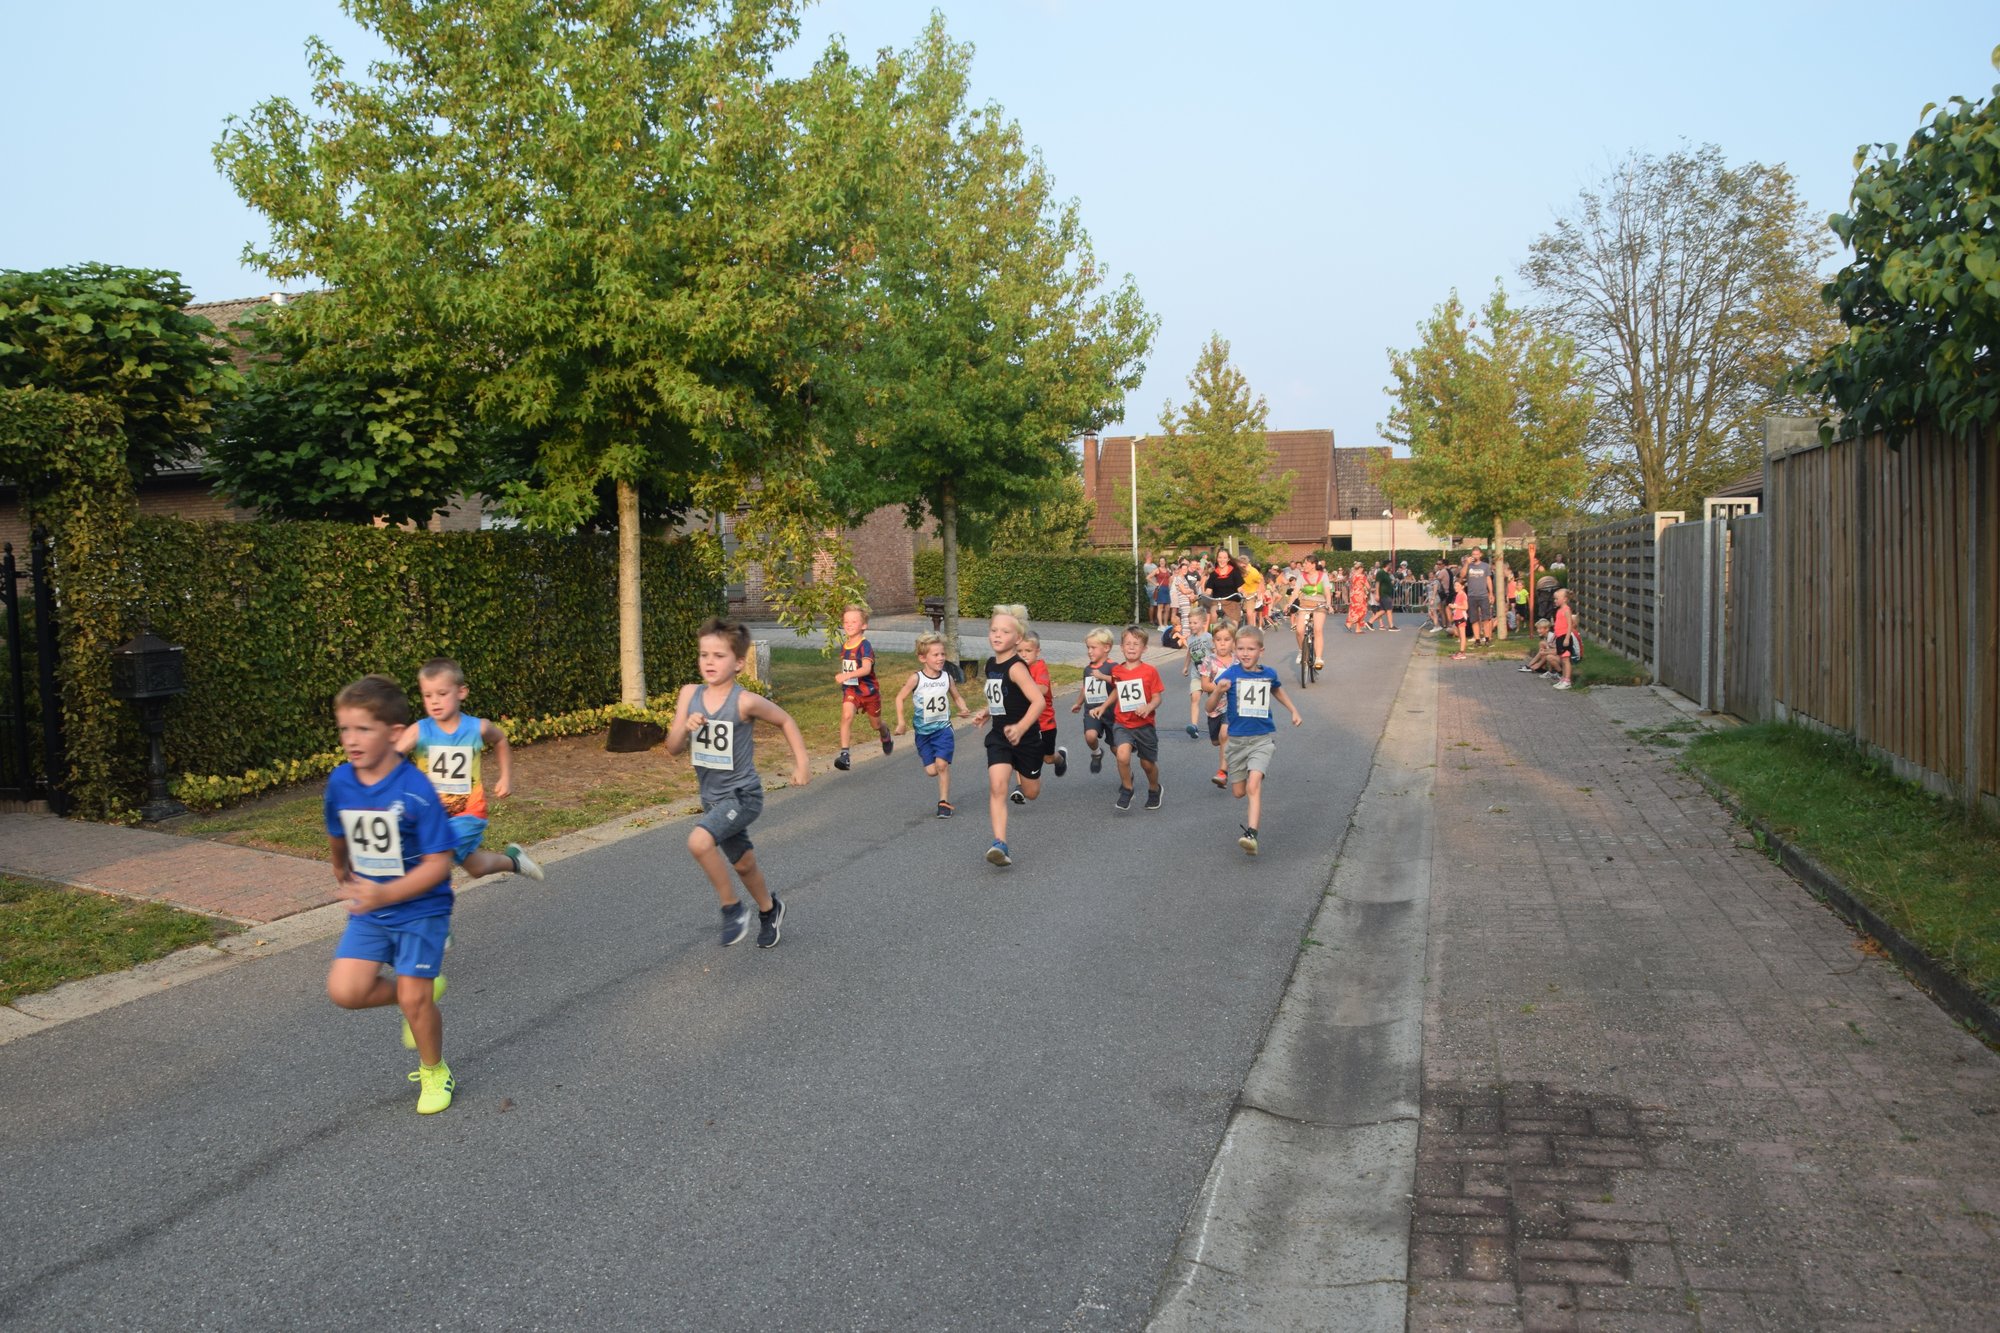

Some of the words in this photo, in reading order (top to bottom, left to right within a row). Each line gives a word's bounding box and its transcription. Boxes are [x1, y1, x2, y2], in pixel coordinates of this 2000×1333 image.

[986, 683, 1001, 704] 46
[1087, 679, 1103, 694] 47
[1120, 683, 1142, 701] 45
[1243, 685, 1266, 706] 41
[926, 695, 947, 713] 43
[696, 722, 728, 751] 48
[432, 751, 467, 779] 42
[352, 815, 392, 853] 49
